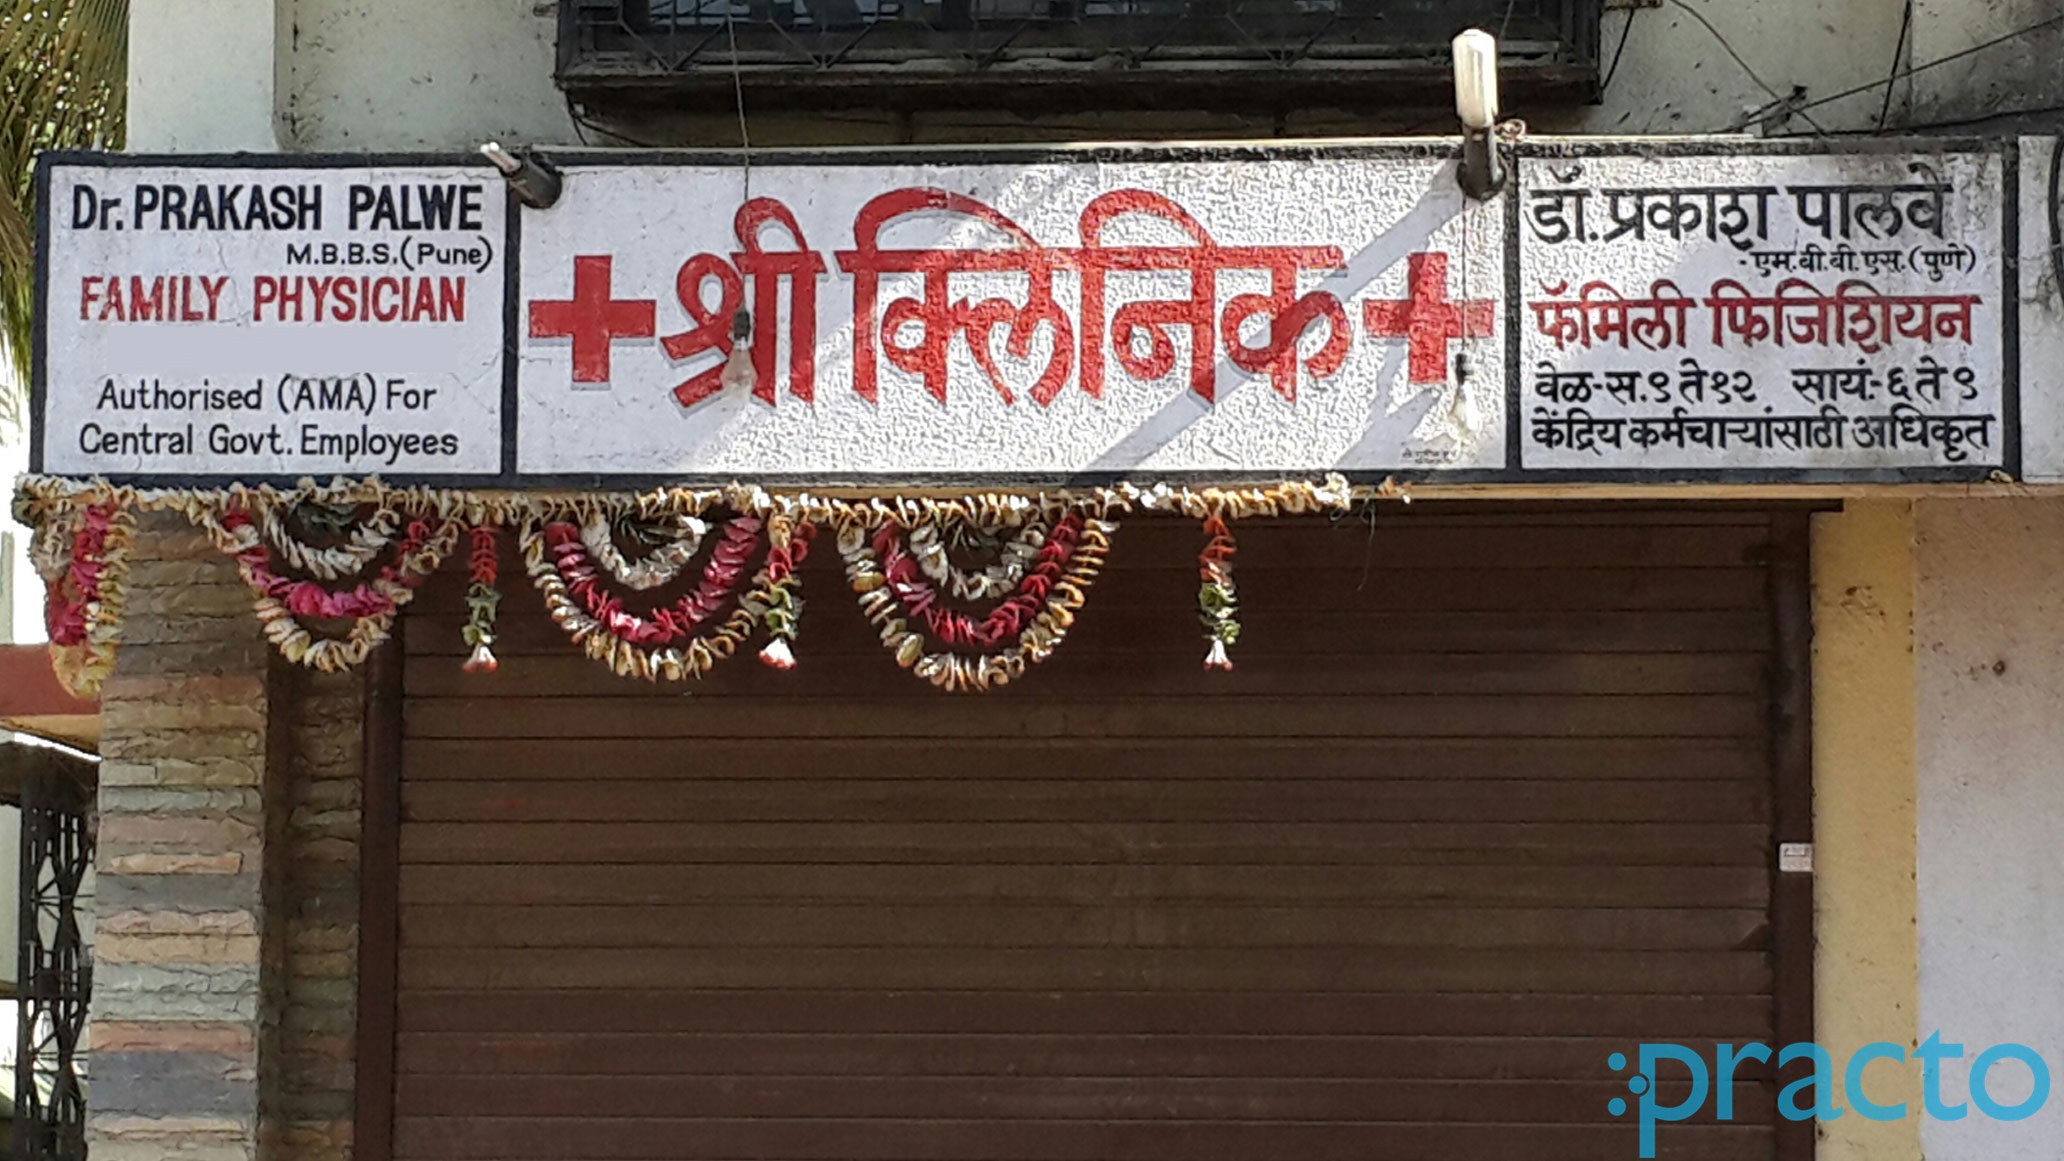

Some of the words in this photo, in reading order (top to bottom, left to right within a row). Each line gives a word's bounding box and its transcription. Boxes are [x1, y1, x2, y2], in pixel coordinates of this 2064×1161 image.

[348, 184, 483, 231] PALWE
[1786, 162, 1954, 241] पालवे
[80, 275, 230, 322] FAMILY
[253, 275, 466, 322] PHYSICIAN
[660, 196, 825, 408] श्री
[836, 187, 1351, 406] क्लिनिक
[1703, 278, 1982, 354] फिजिशियन
[96, 378, 263, 411] Authorised
[277, 373, 377, 416] (AMA)
[386, 379, 437, 411] For
[78, 423, 194, 456] Central
[208, 423, 293, 457] Govt.
[300, 423, 460, 466] Employees
[1851, 402, 1997, 462] अधिकृत
